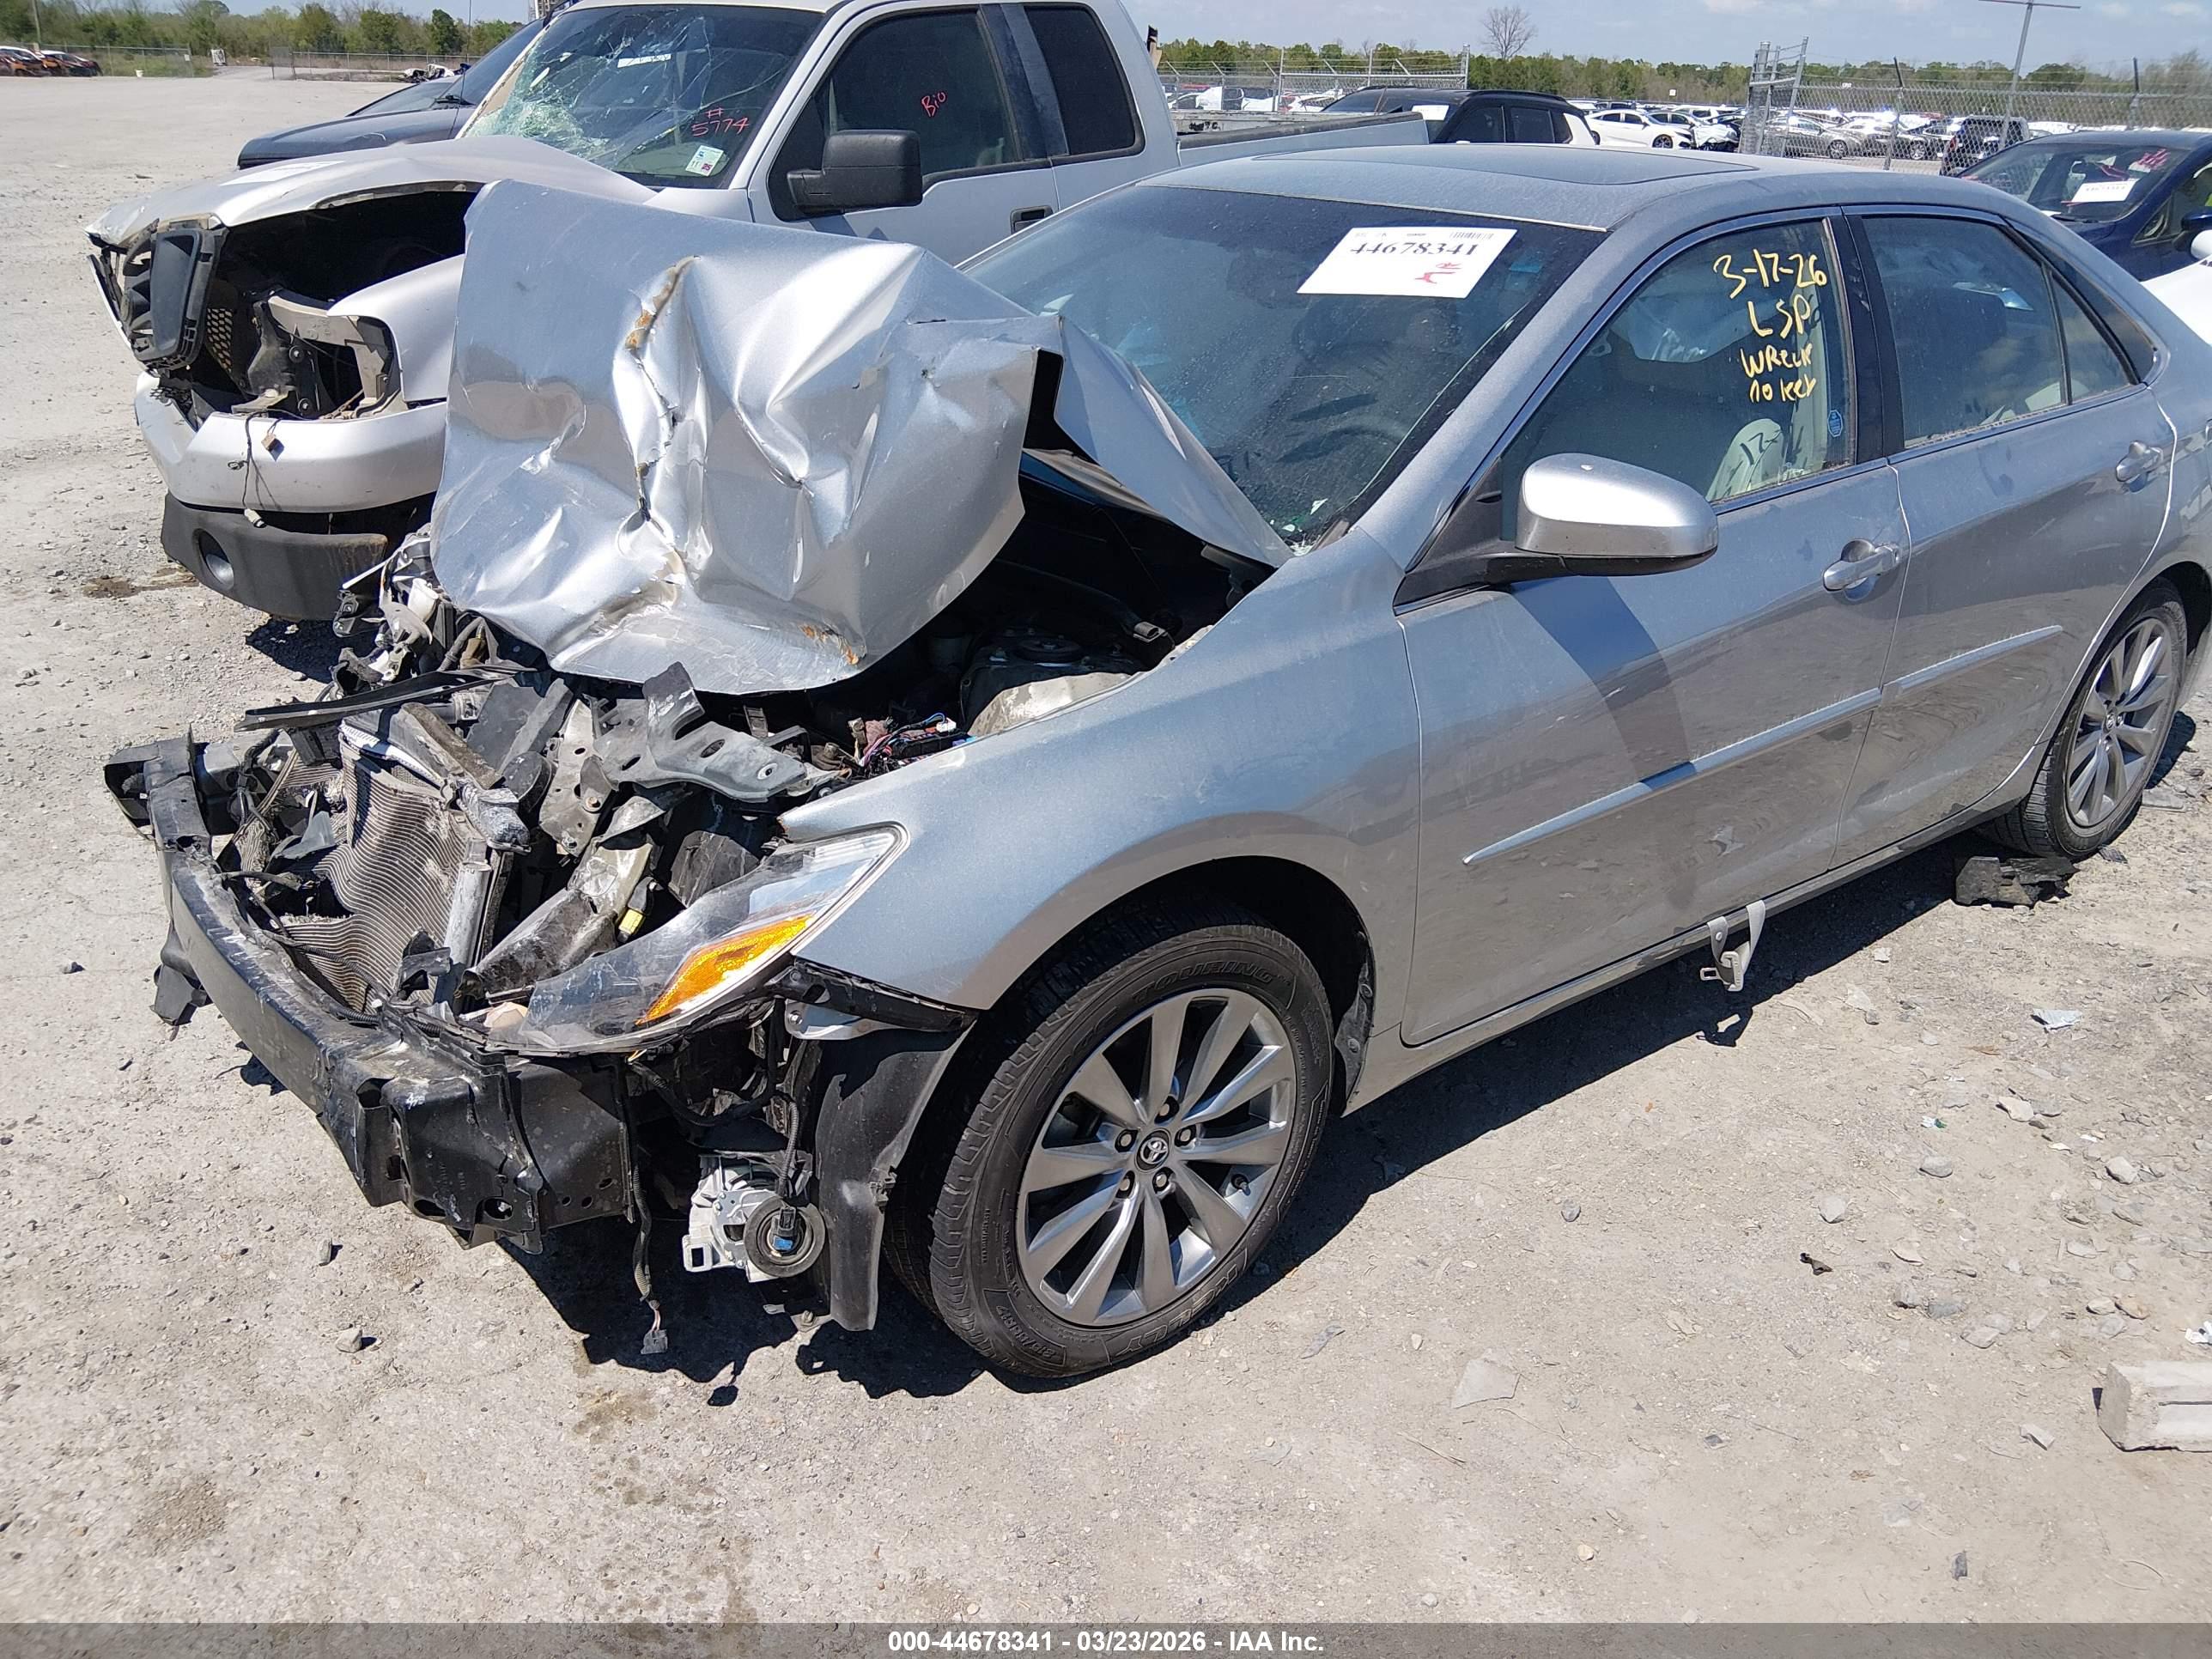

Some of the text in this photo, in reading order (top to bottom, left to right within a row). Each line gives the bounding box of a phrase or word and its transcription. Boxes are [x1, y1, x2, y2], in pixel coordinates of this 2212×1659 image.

[691, 117, 750, 137] 5774
[1350, 242, 1479, 256] 44678341
[1713, 248, 1827, 299] 3-17-26
[1747, 294, 1812, 339] LSP
[1132, 960, 1273, 1004] TOURING
[1115, 1263, 1238, 1357] KELLY
